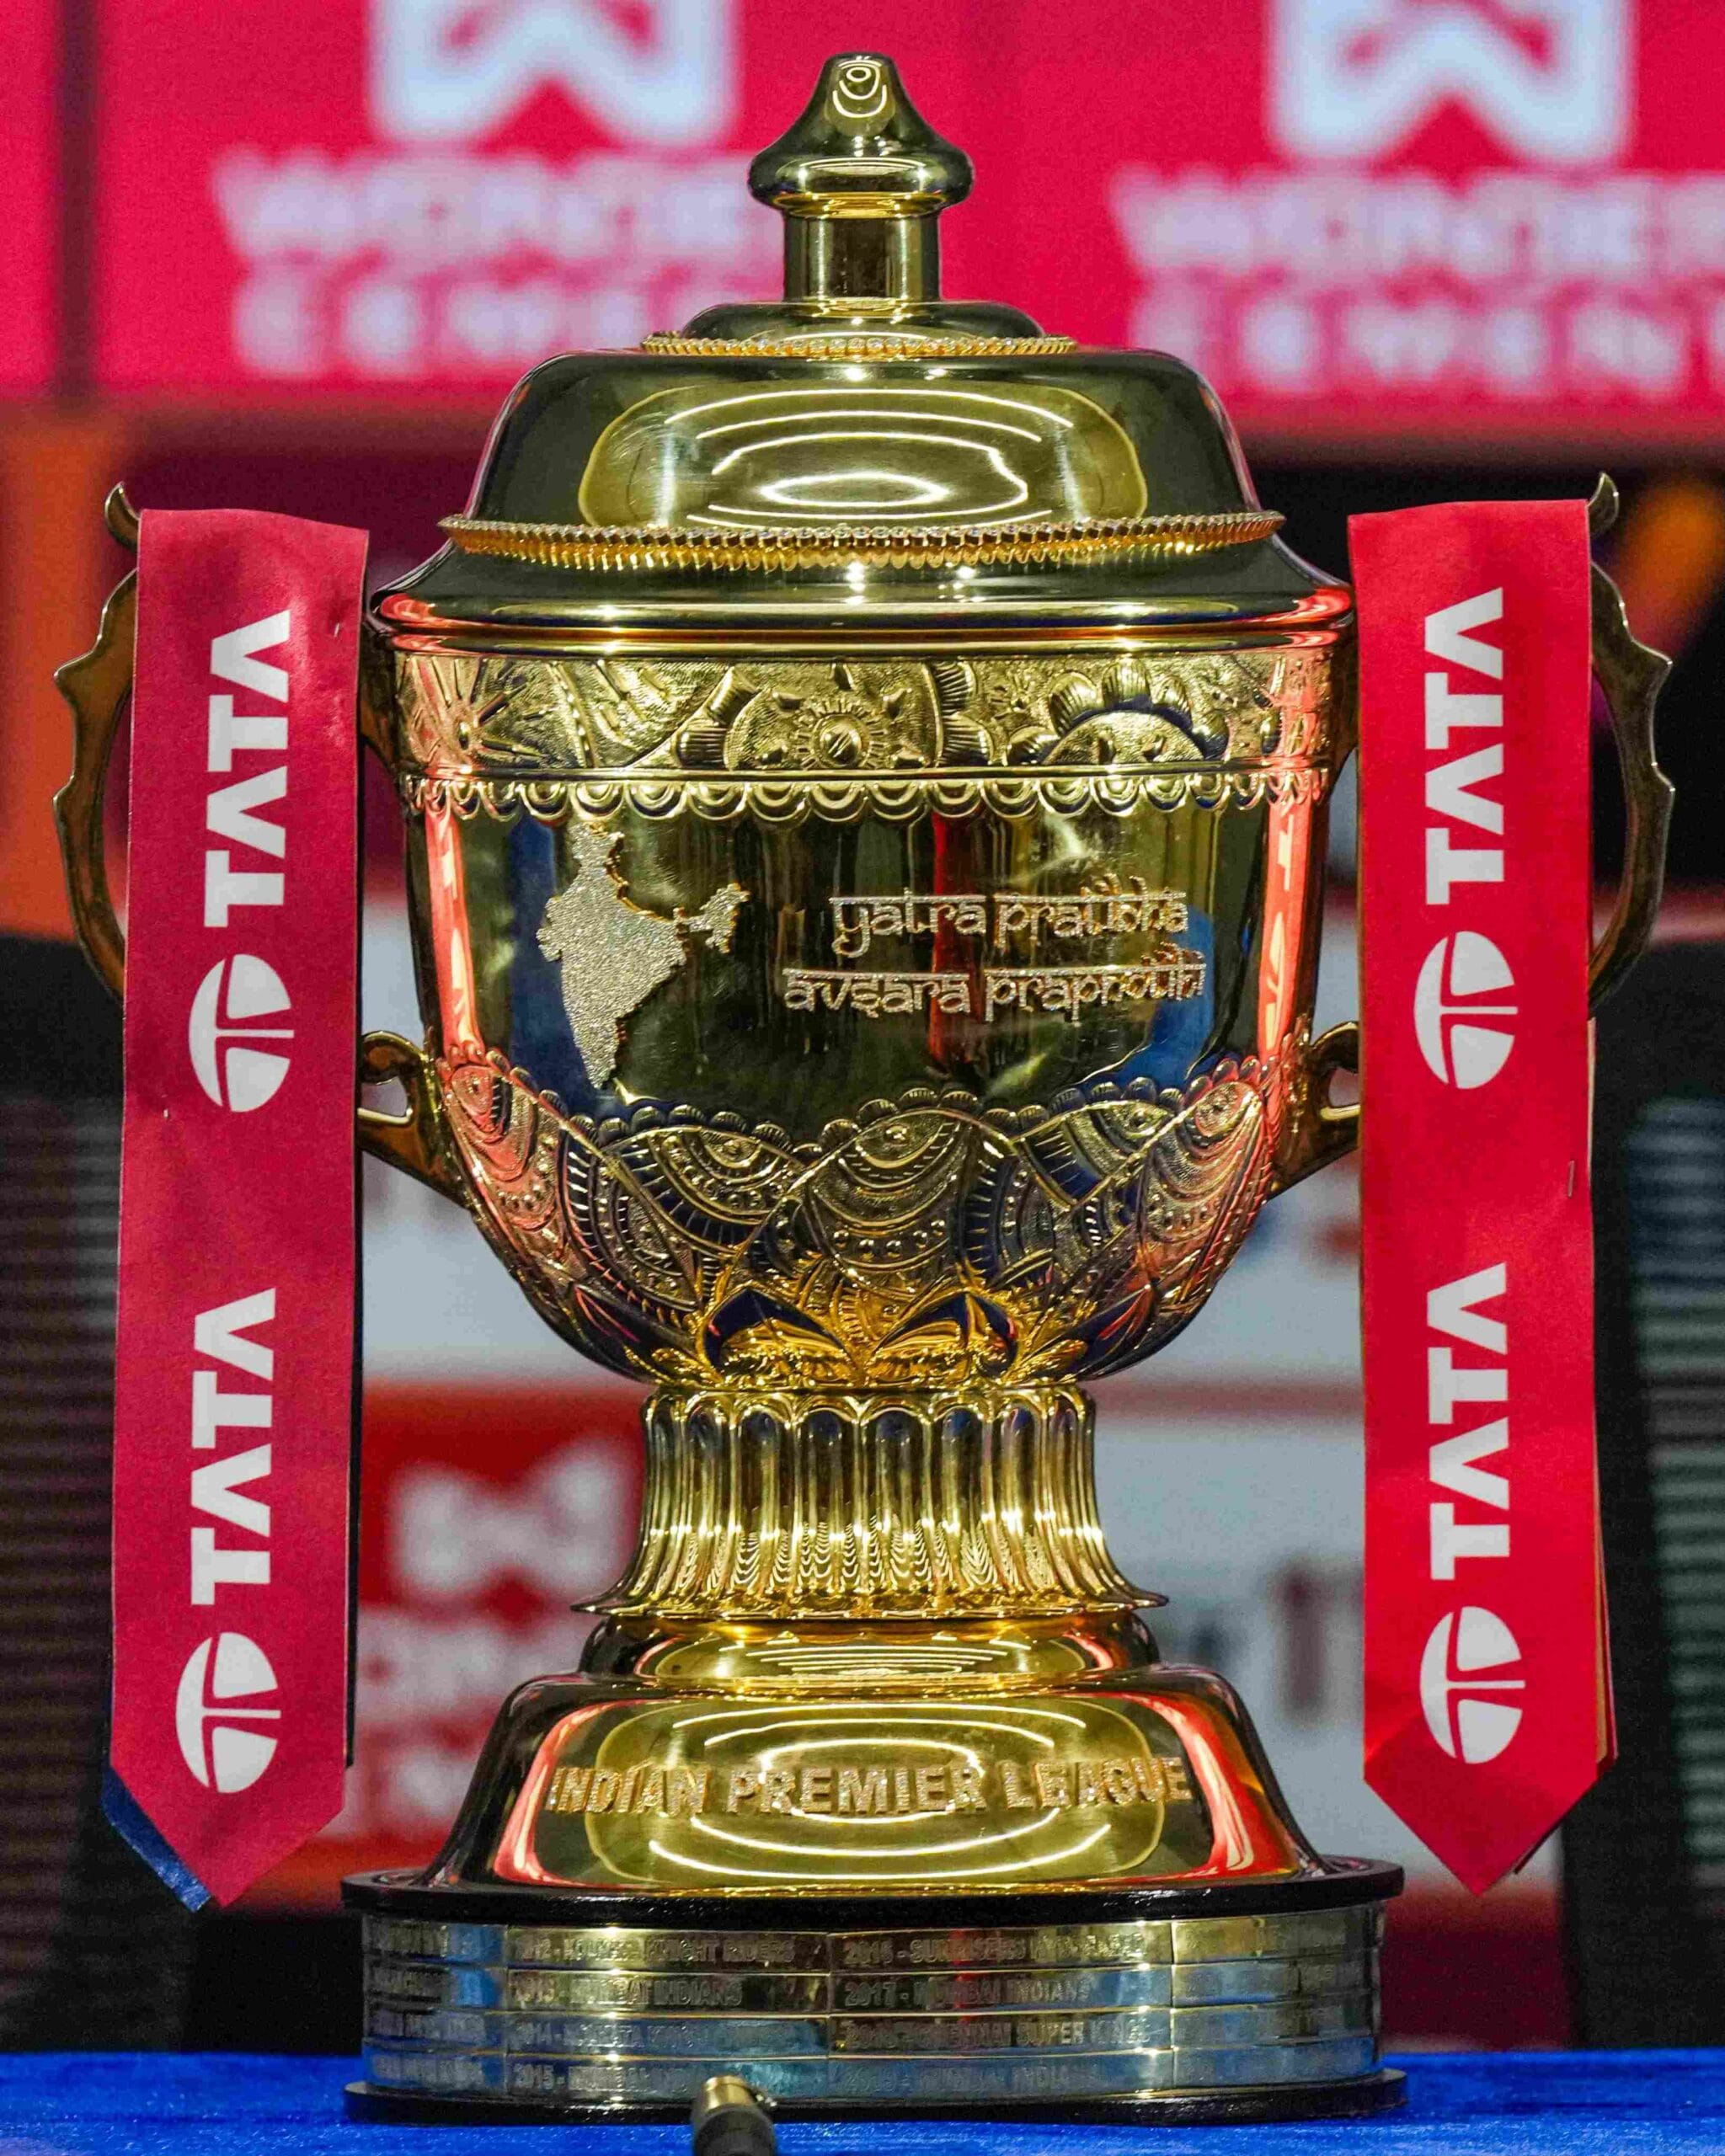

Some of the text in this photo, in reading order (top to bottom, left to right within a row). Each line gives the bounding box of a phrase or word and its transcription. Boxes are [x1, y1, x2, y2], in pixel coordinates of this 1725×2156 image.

[204, 610, 291, 927] TATA
[1424, 587, 1504, 905] TATA
[191, 1287, 276, 1605] TATA
[1427, 1262, 1510, 1580] TATA
[546, 1757, 1193, 1814] INDIAN PREMIER LEAGUE
